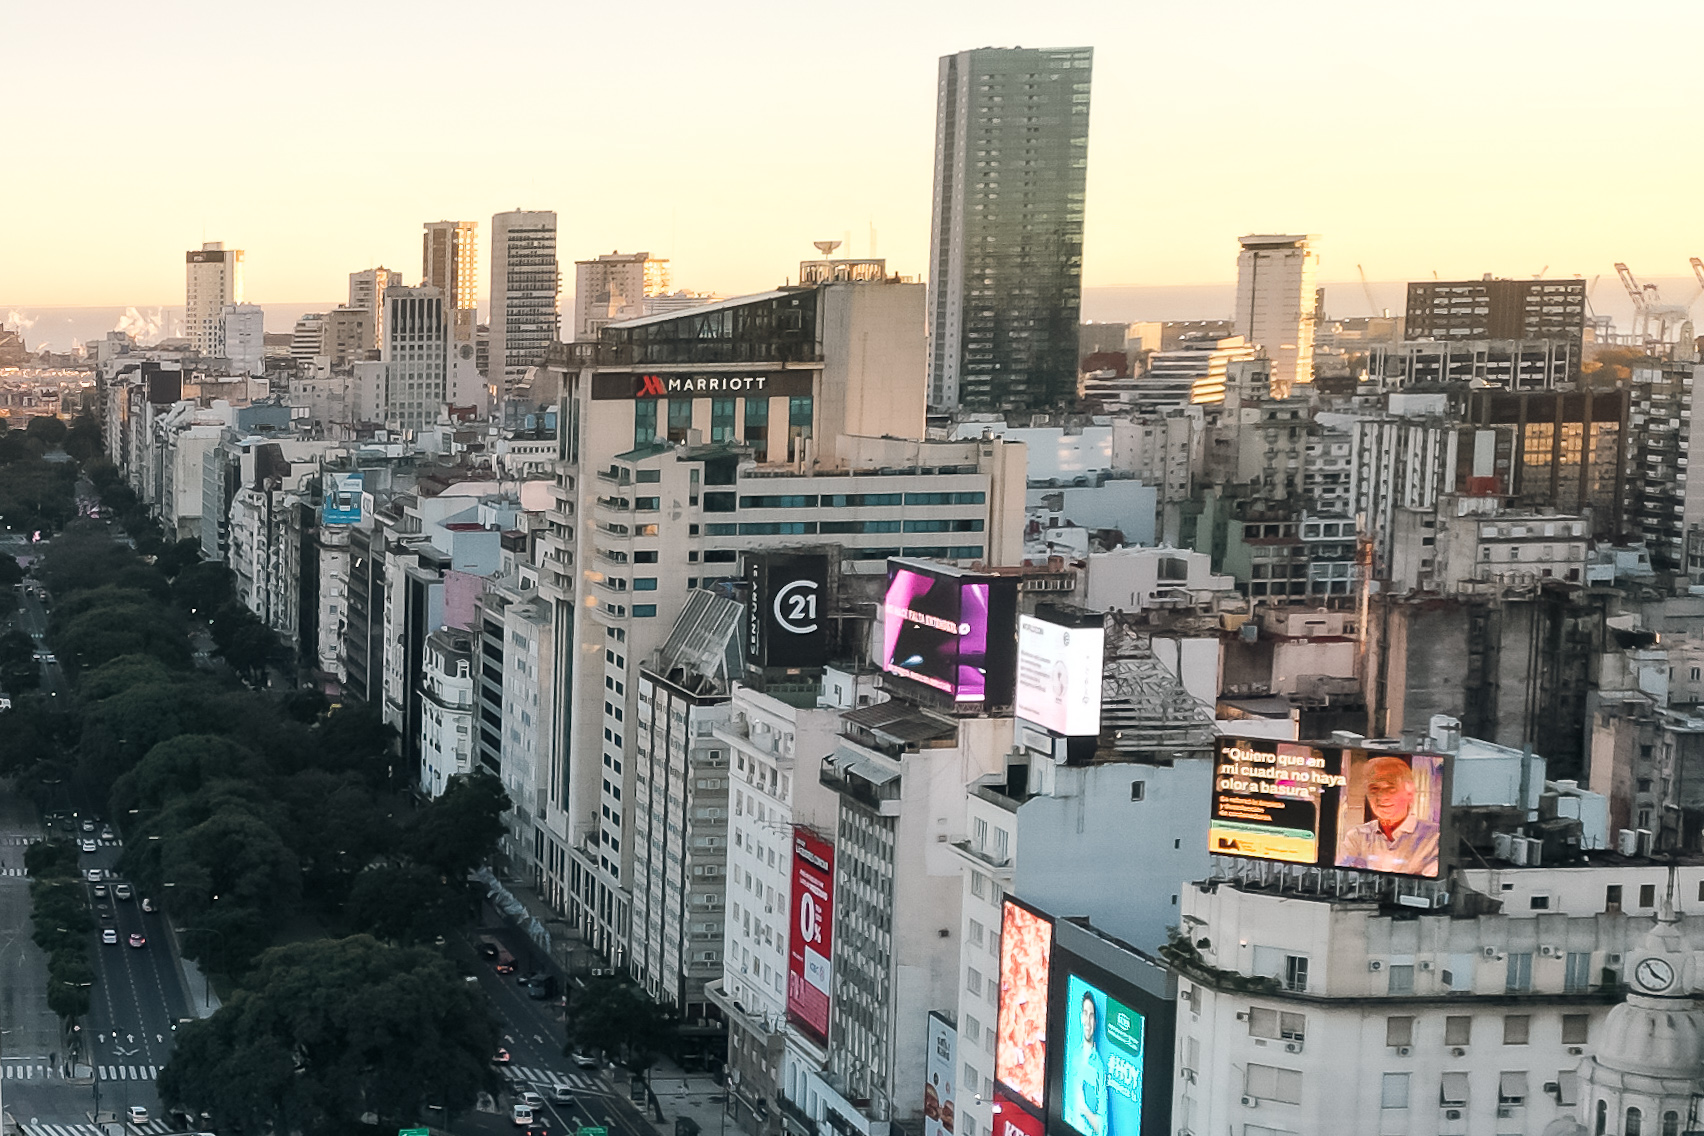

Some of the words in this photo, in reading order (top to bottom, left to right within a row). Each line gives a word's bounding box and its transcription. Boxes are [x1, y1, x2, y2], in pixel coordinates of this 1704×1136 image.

[668, 377, 766, 391] MARRIOTT
[1278, 754, 1305, 767] que
[1220, 763, 1239, 775] mi
[1240, 766, 1289, 780] cuadra
[1291, 771, 1310, 782] no
[1311, 771, 1347, 787] haya
[1220, 778, 1250, 791] olor
[1249, 782, 1259, 793] a
